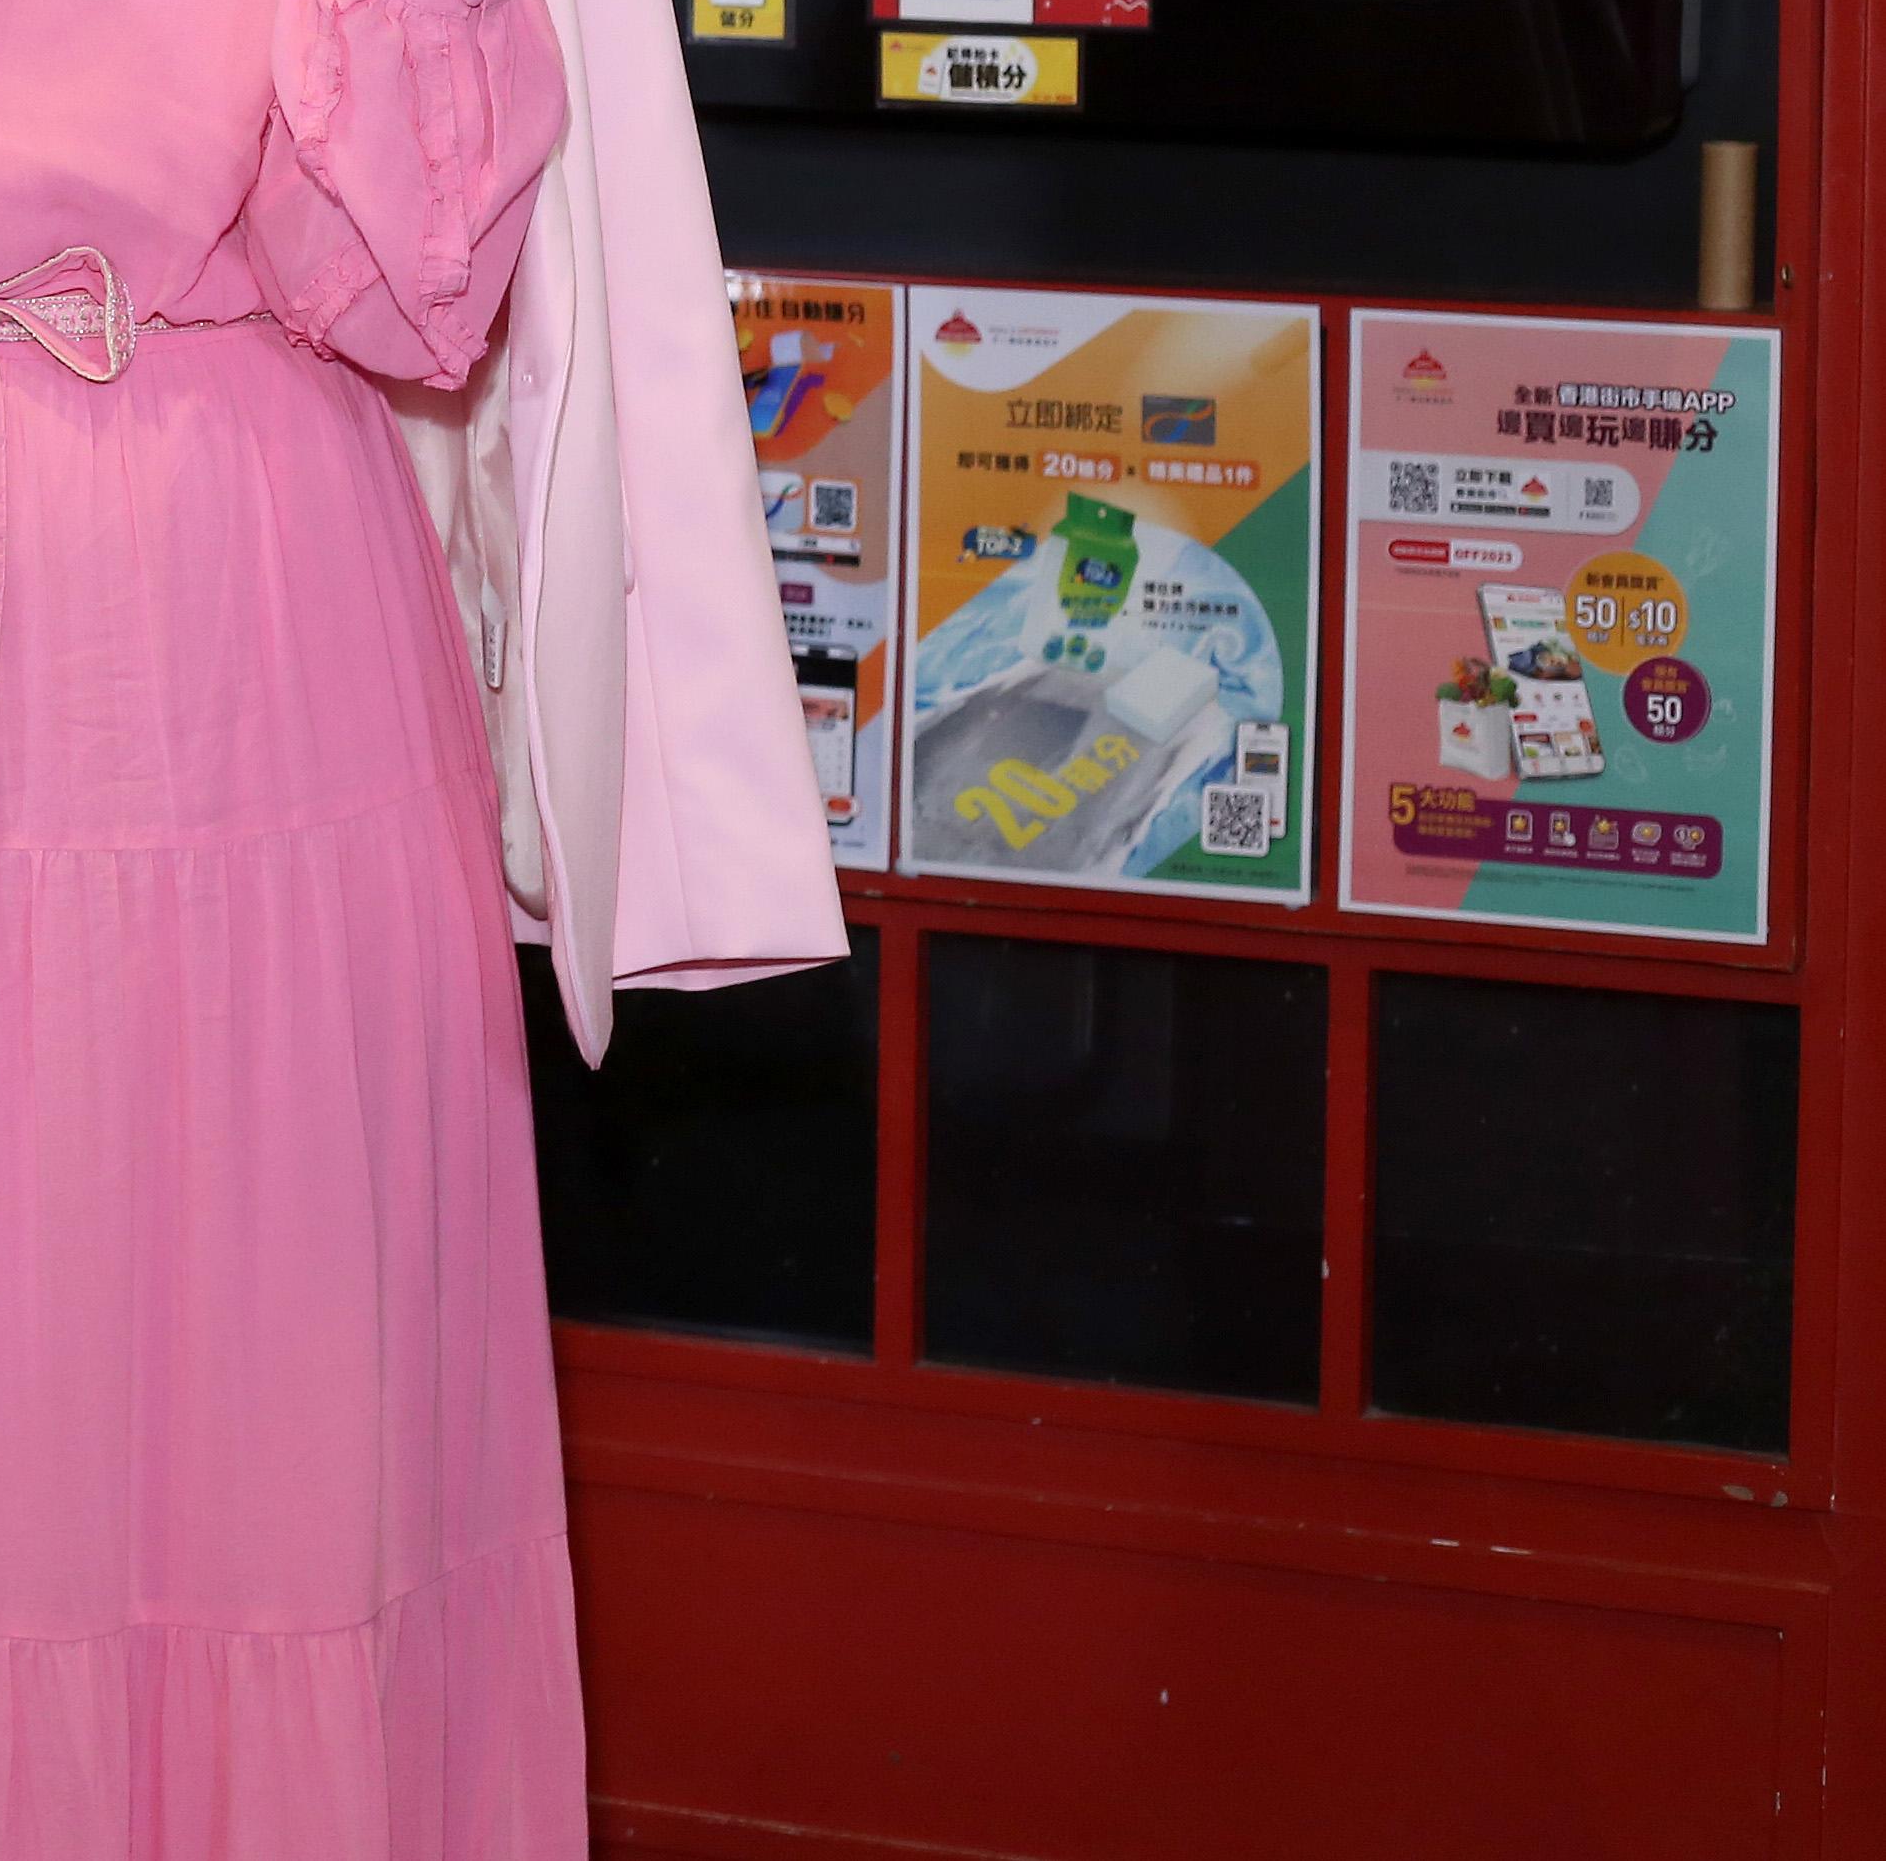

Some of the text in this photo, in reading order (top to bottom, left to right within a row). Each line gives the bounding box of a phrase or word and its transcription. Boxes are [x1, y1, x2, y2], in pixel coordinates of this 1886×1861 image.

[949, 64, 1027, 90] 儲積分
[1576, 595, 1677, 634] 50 $10
[1646, 694, 1683, 726] 50
